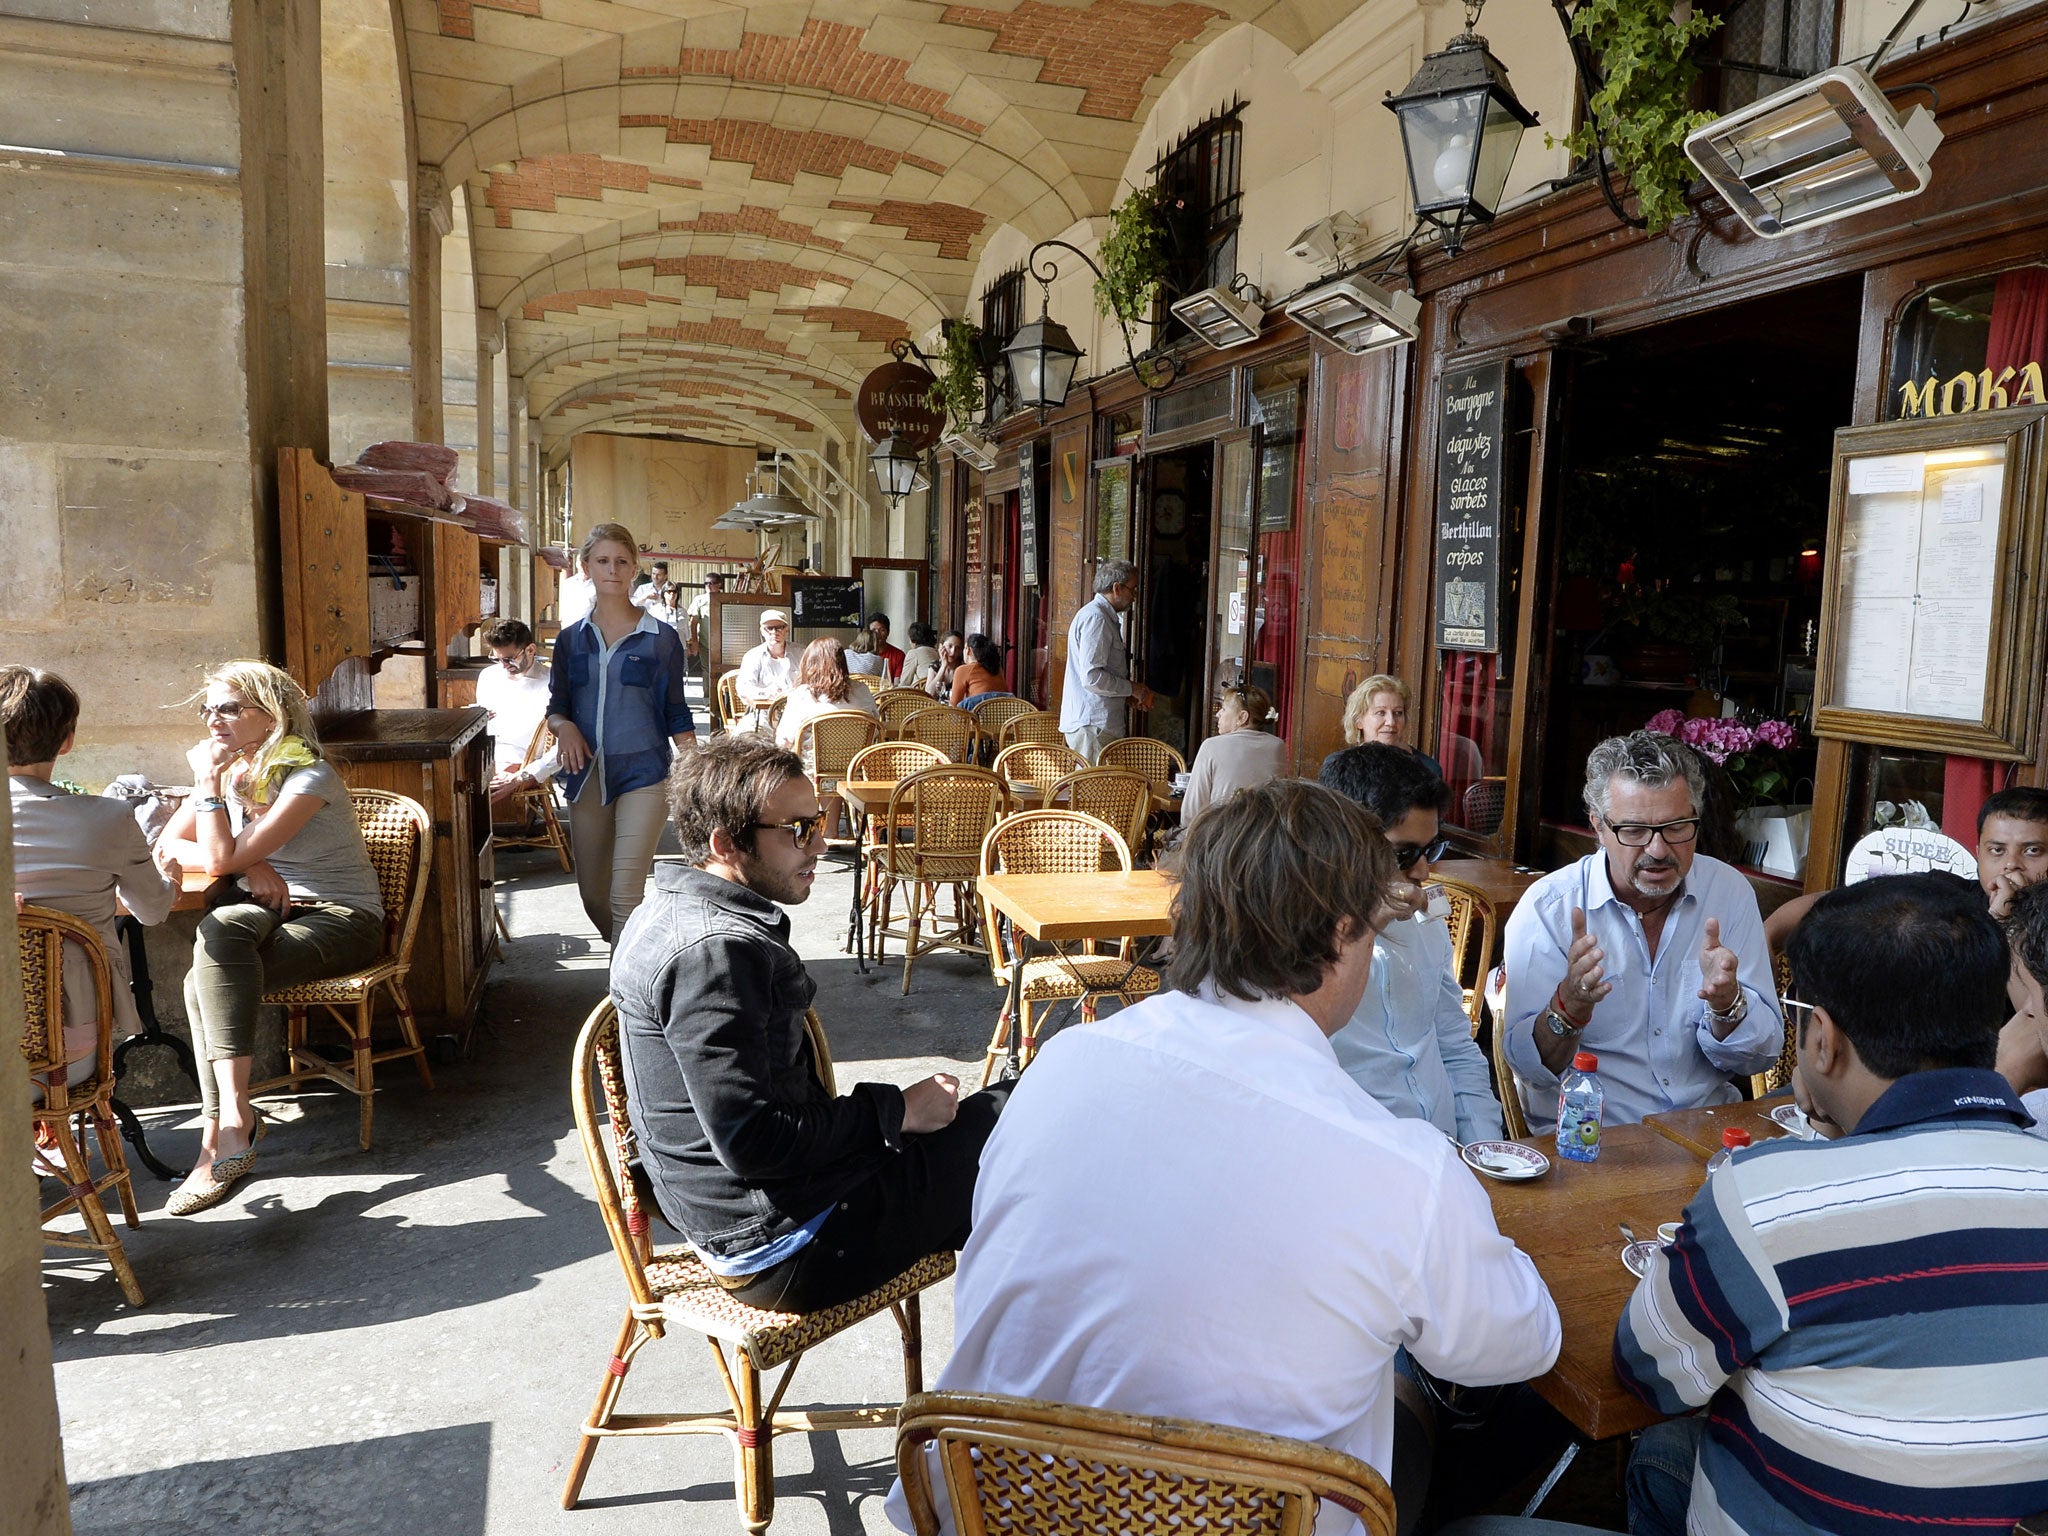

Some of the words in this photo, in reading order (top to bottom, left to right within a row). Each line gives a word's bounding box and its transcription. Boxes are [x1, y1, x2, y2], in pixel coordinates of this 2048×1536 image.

[870, 392, 924, 408] BRASSER
[1896, 361, 2048, 421] MOKA
[1445, 390, 1495, 422] Bourgogne
[877, 420, 929, 434] mtzig
[1446, 431, 1491, 464] dégustez
[1460, 461, 1475, 475] Nos
[1450, 491, 1488, 511] sorbets
[1441, 520, 1492, 543] Berthillon
[1885, 837, 1951, 861] SUPER
